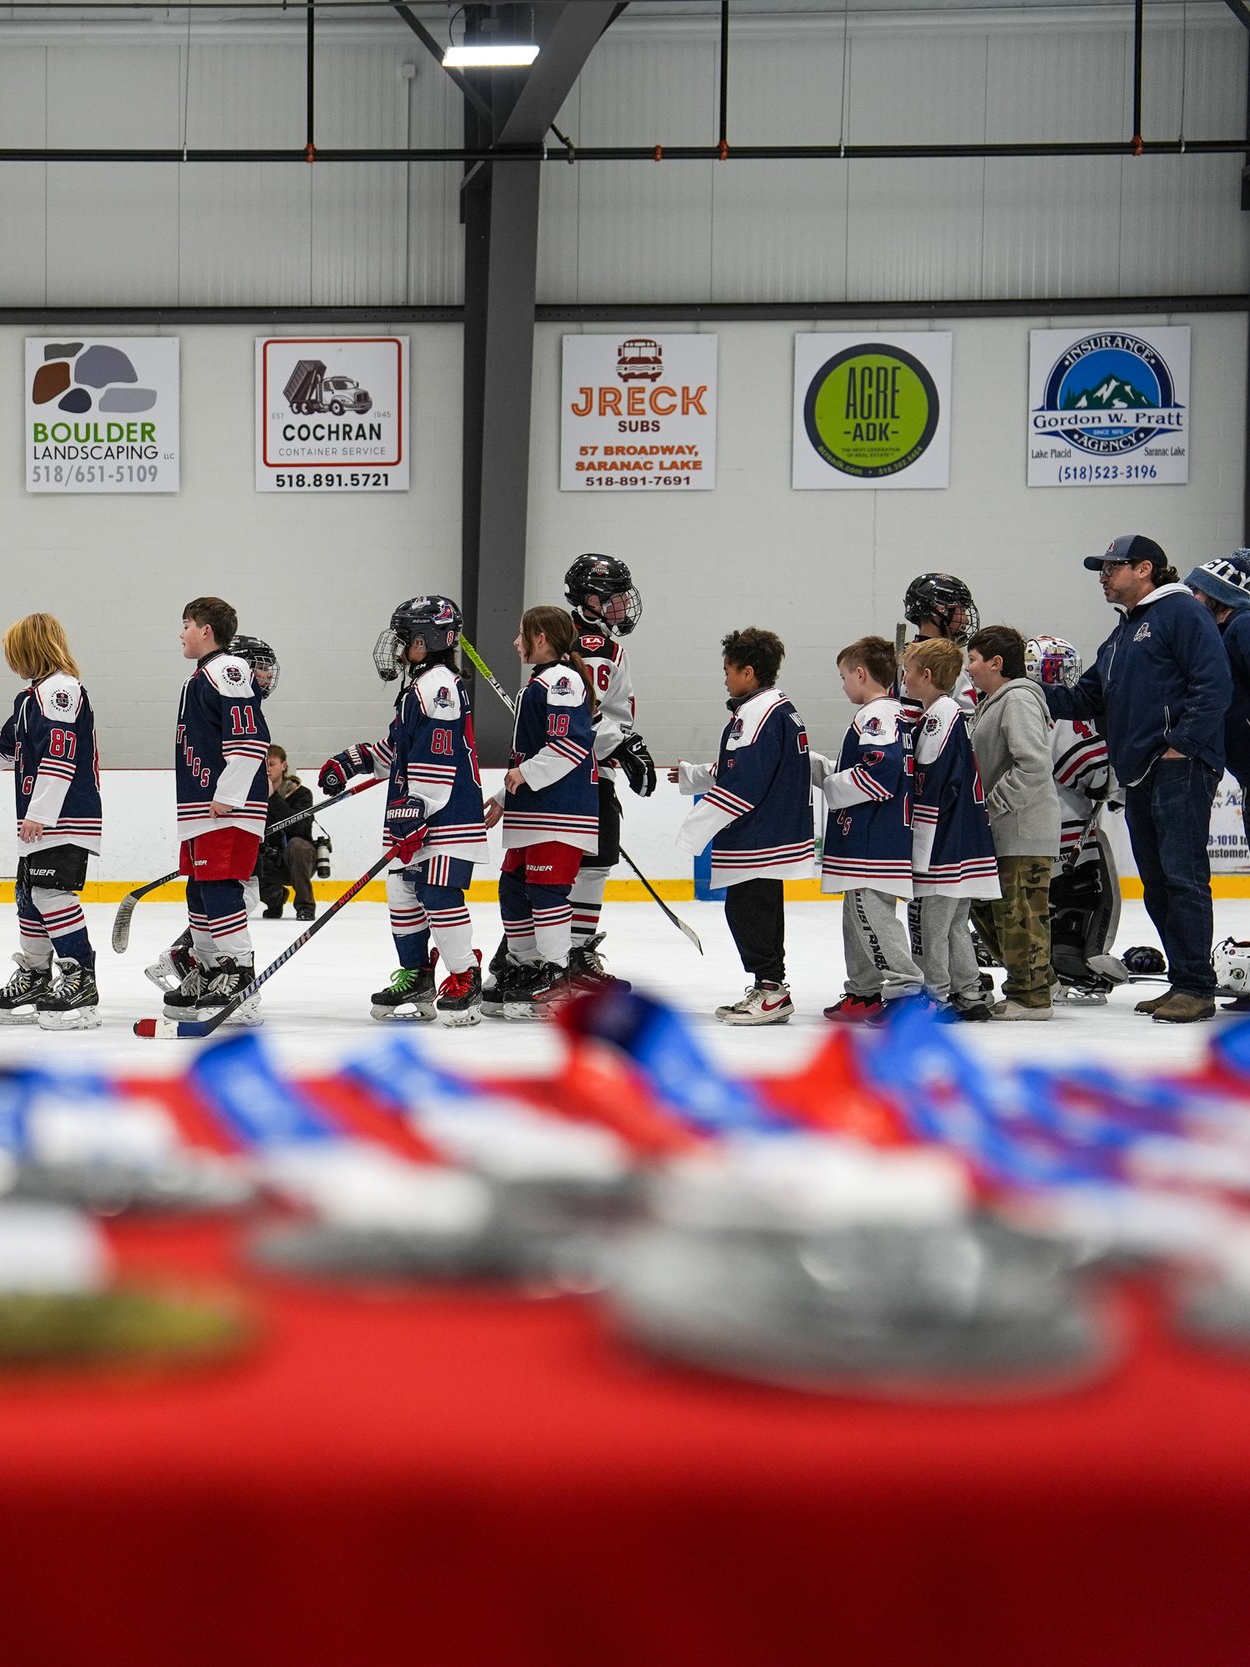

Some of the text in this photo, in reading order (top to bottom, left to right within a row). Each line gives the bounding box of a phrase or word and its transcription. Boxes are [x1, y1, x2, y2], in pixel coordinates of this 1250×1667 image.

[1066, 336, 1152, 364] INSURANCE
[571, 385, 707, 417] JRECK
[845, 367, 901, 420] ACRE
[618, 420, 660, 432] SUBS
[1034, 412, 1183, 428] Gordon W. Pratt
[34, 422, 156, 443] BOULDER
[283, 423, 382, 441] COCHRAN
[278, 446, 386, 456] CONTAINER SERVICE
[579, 445, 699, 457] 57 BROADWAY,
[1078, 433, 1137, 452] AGENCY
[1145, 447, 1185, 456] Saranac Lake
[34, 446, 158, 460] LANDSCAPING
[1032, 449, 1071, 458] Lake Placid
[575, 460, 702, 471] SARANAC LAKE
[1058, 465, 1157, 483] (518)523-3196
[32, 465, 158, 487] 518/651-5109
[276, 473, 389, 487] 518.891.5721
[586, 476, 691, 486] 518-891-7691
[231, 706, 257, 735] 11
[547, 714, 570, 736] 18
[50, 728, 77, 760] 87
[431, 727, 454, 755] 81
[338, 872, 371, 907] NOVIUM
[240, 930, 312, 1002] WARRIOR
